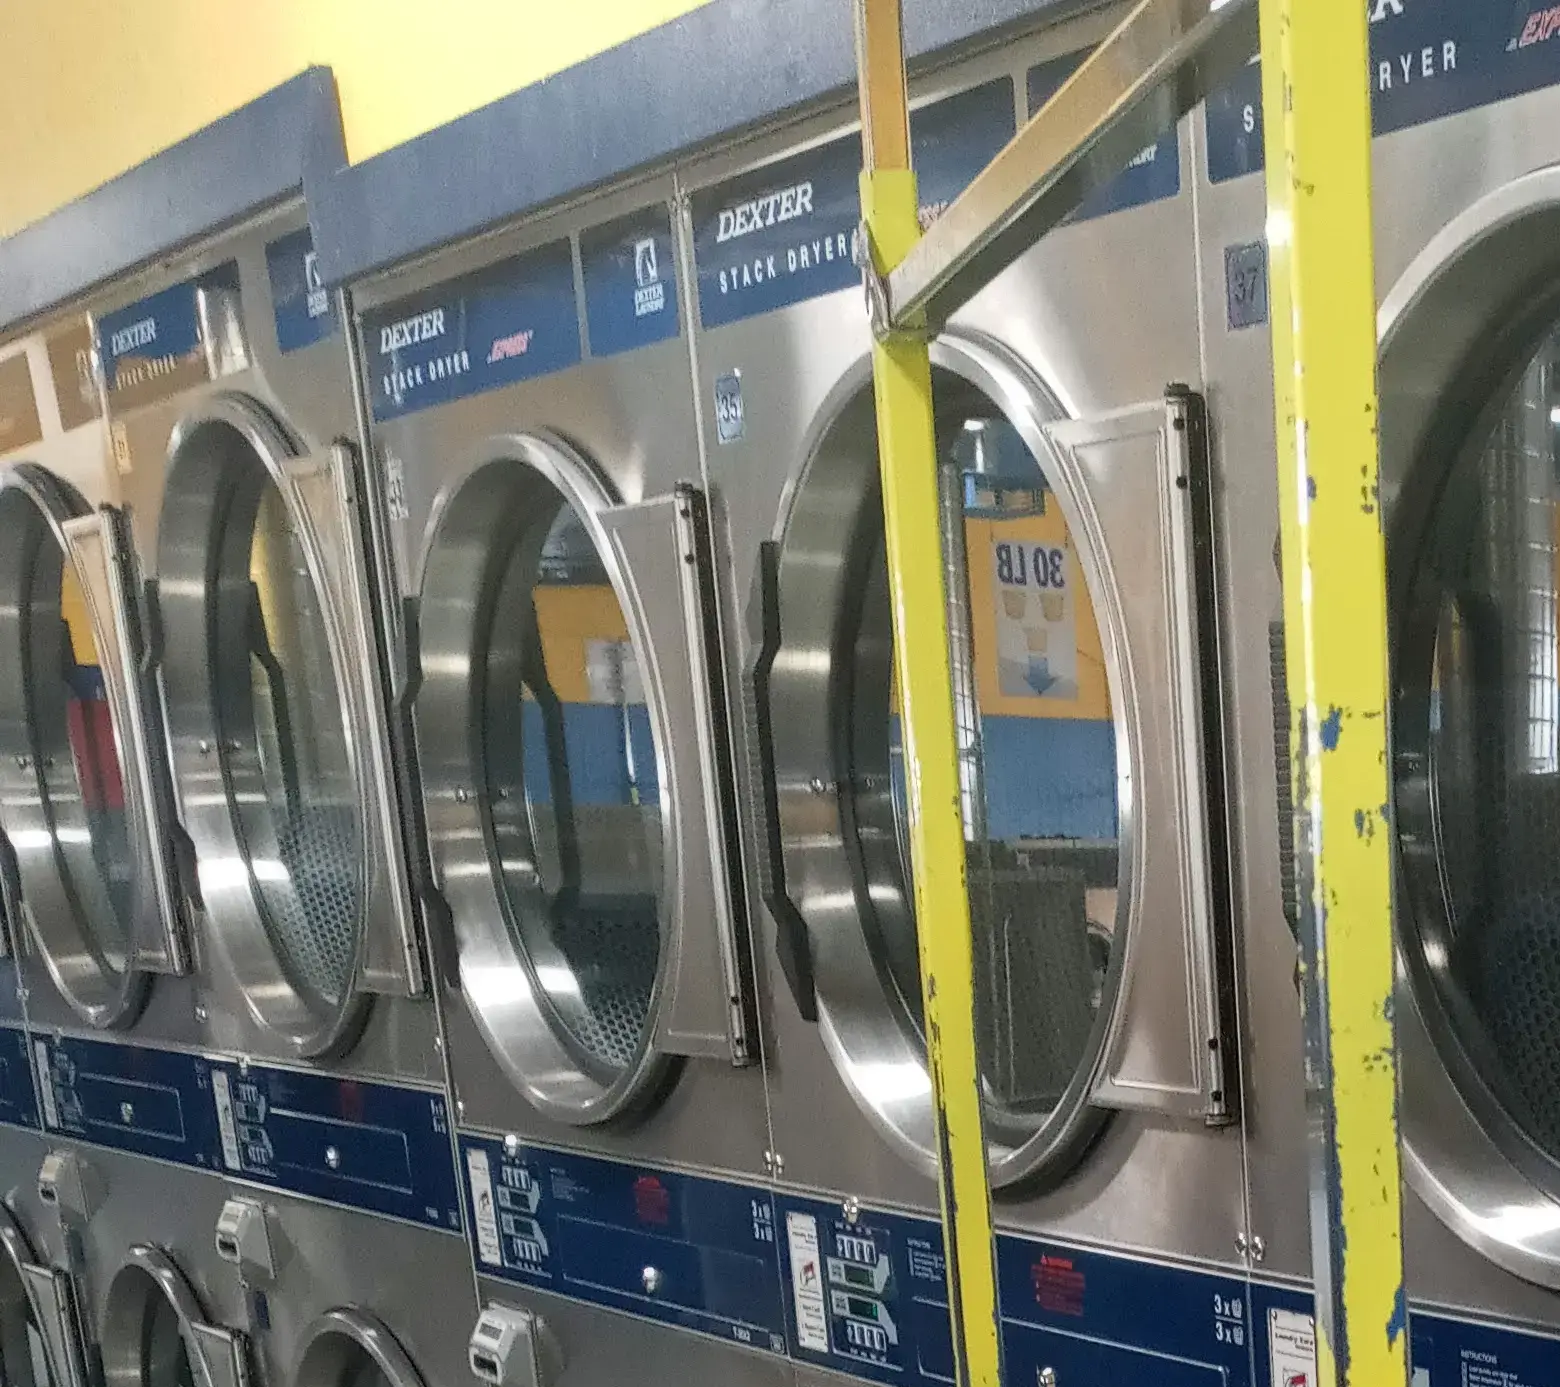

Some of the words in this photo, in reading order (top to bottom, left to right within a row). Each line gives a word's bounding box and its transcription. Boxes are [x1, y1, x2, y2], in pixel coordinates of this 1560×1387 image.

[1379, 40, 1457, 91] RYER
[716, 180, 813, 243] DEXTER
[719, 255, 776, 294] STACK
[787, 232, 847, 273] DRYER
[1234, 267, 1258, 303] 37
[111, 316, 157, 357] DEXTER
[380, 308, 445, 353] DEXTER
[428, 350, 470, 381] DRYER
[722, 391, 738, 421] 35
[1214, 1294, 1222, 1315] 3
[1215, 1321, 1223, 1342] 3
